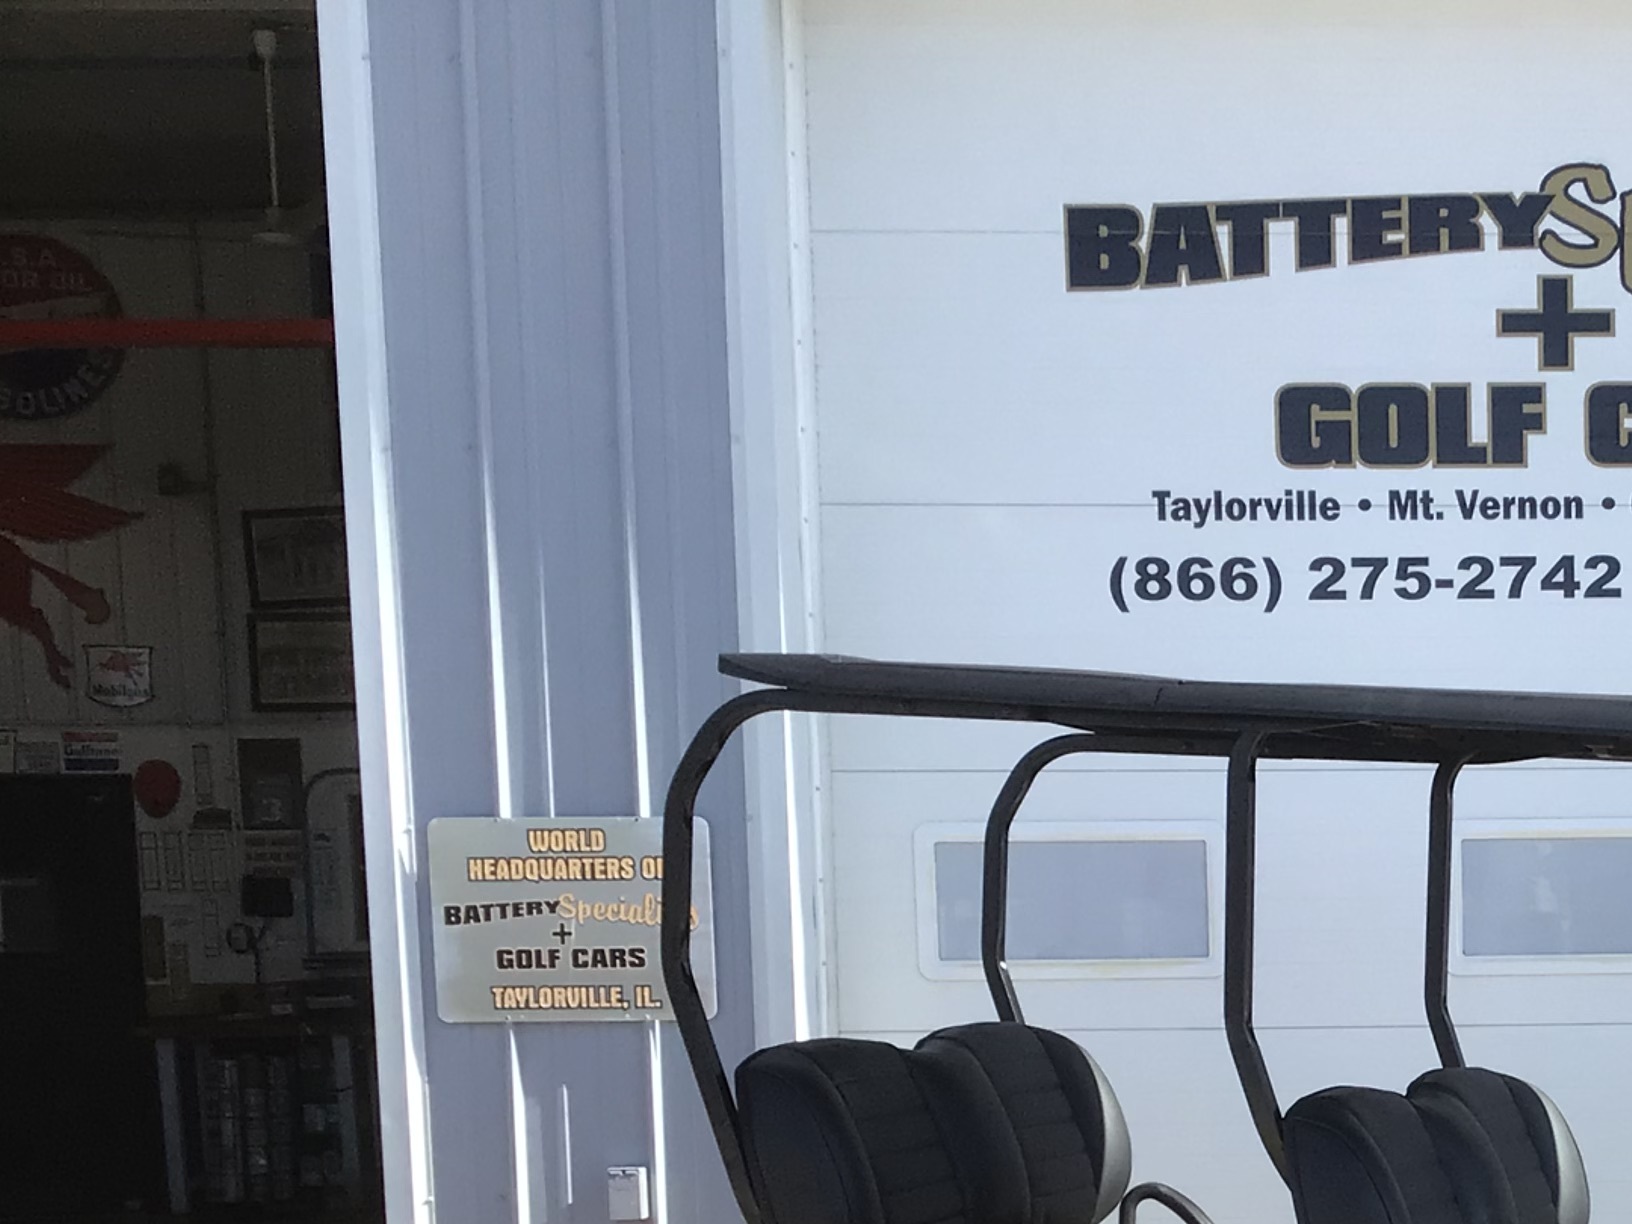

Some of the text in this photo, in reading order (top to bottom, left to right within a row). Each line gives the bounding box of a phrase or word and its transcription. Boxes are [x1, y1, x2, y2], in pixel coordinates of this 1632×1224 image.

[1063, 192, 1556, 292] BATTERY
[1274, 381, 1547, 469] GOLF
[1152, 489, 1341, 528] Taylorville
[1388, 489, 1444, 521] Mt.
[1456, 489, 1584, 521] Vernon
[1109, 556, 1282, 613] (866)
[1308, 554, 1623, 601] 275-2742
[527, 828, 606, 852] WORLD
[466, 855, 635, 883] HEADQUARTERS
[443, 900, 562, 926] BATTERY
[496, 947, 646, 969] GOLF CARS
[490, 985, 662, 1010] TAYLORVILLE, IL.
